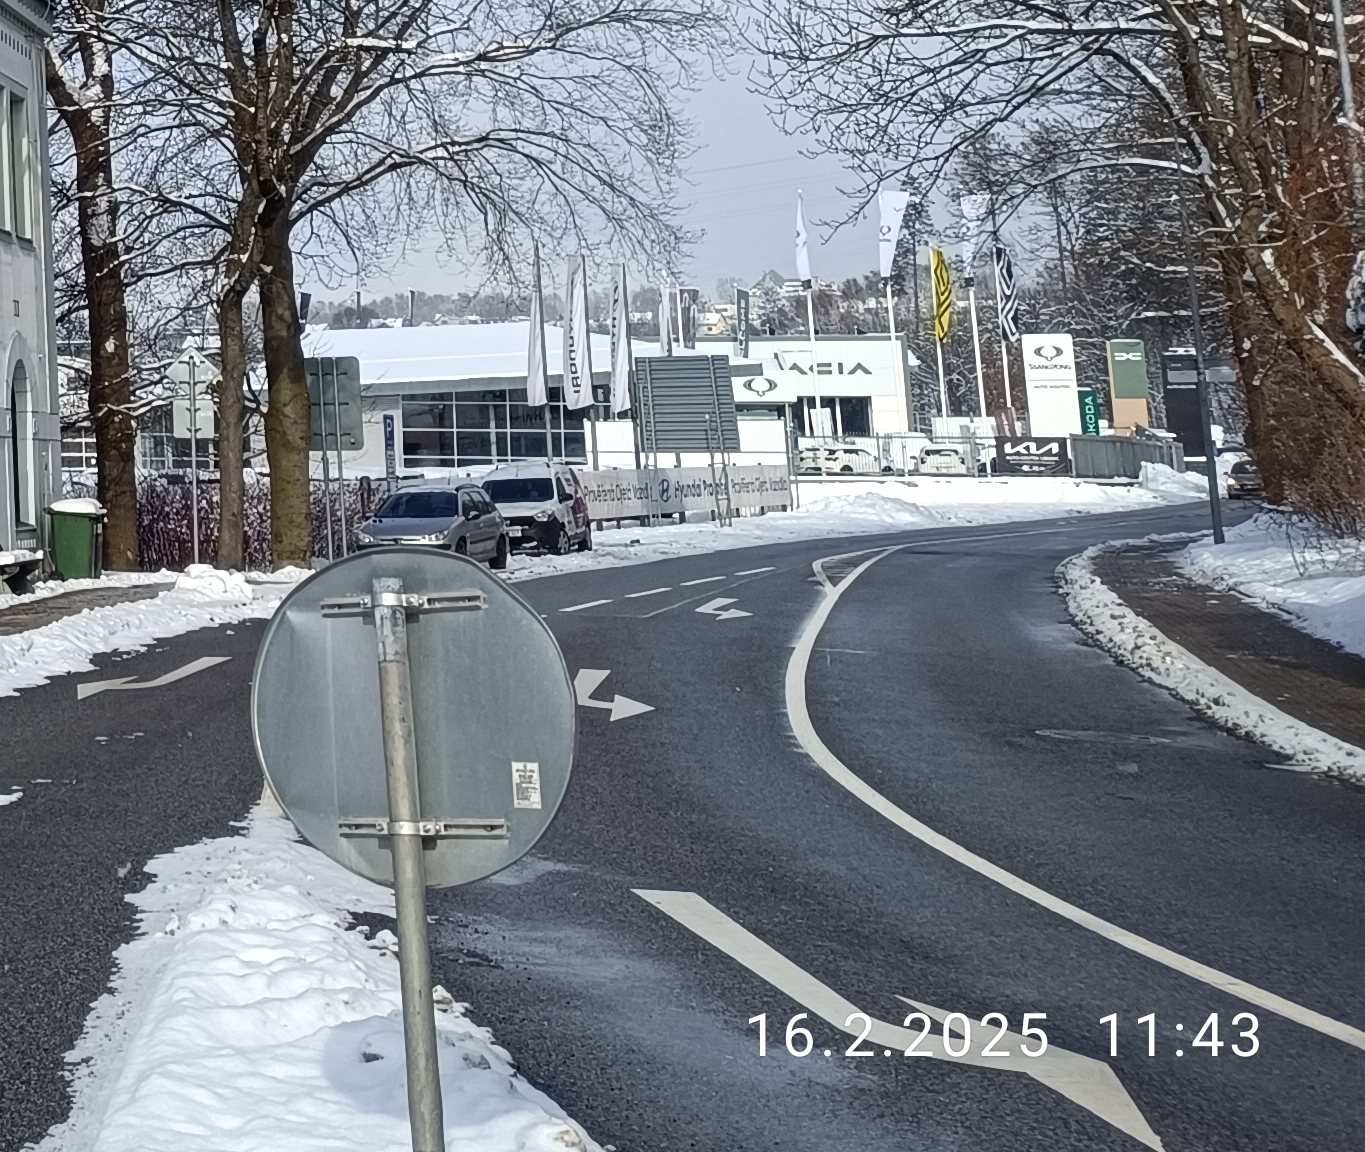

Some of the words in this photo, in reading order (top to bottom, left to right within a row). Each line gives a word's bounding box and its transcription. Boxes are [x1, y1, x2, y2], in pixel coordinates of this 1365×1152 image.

[788, 362, 873, 375] ACIA
[1084, 395, 1097, 436] KODA
[1003, 441, 1060, 455] KIA
